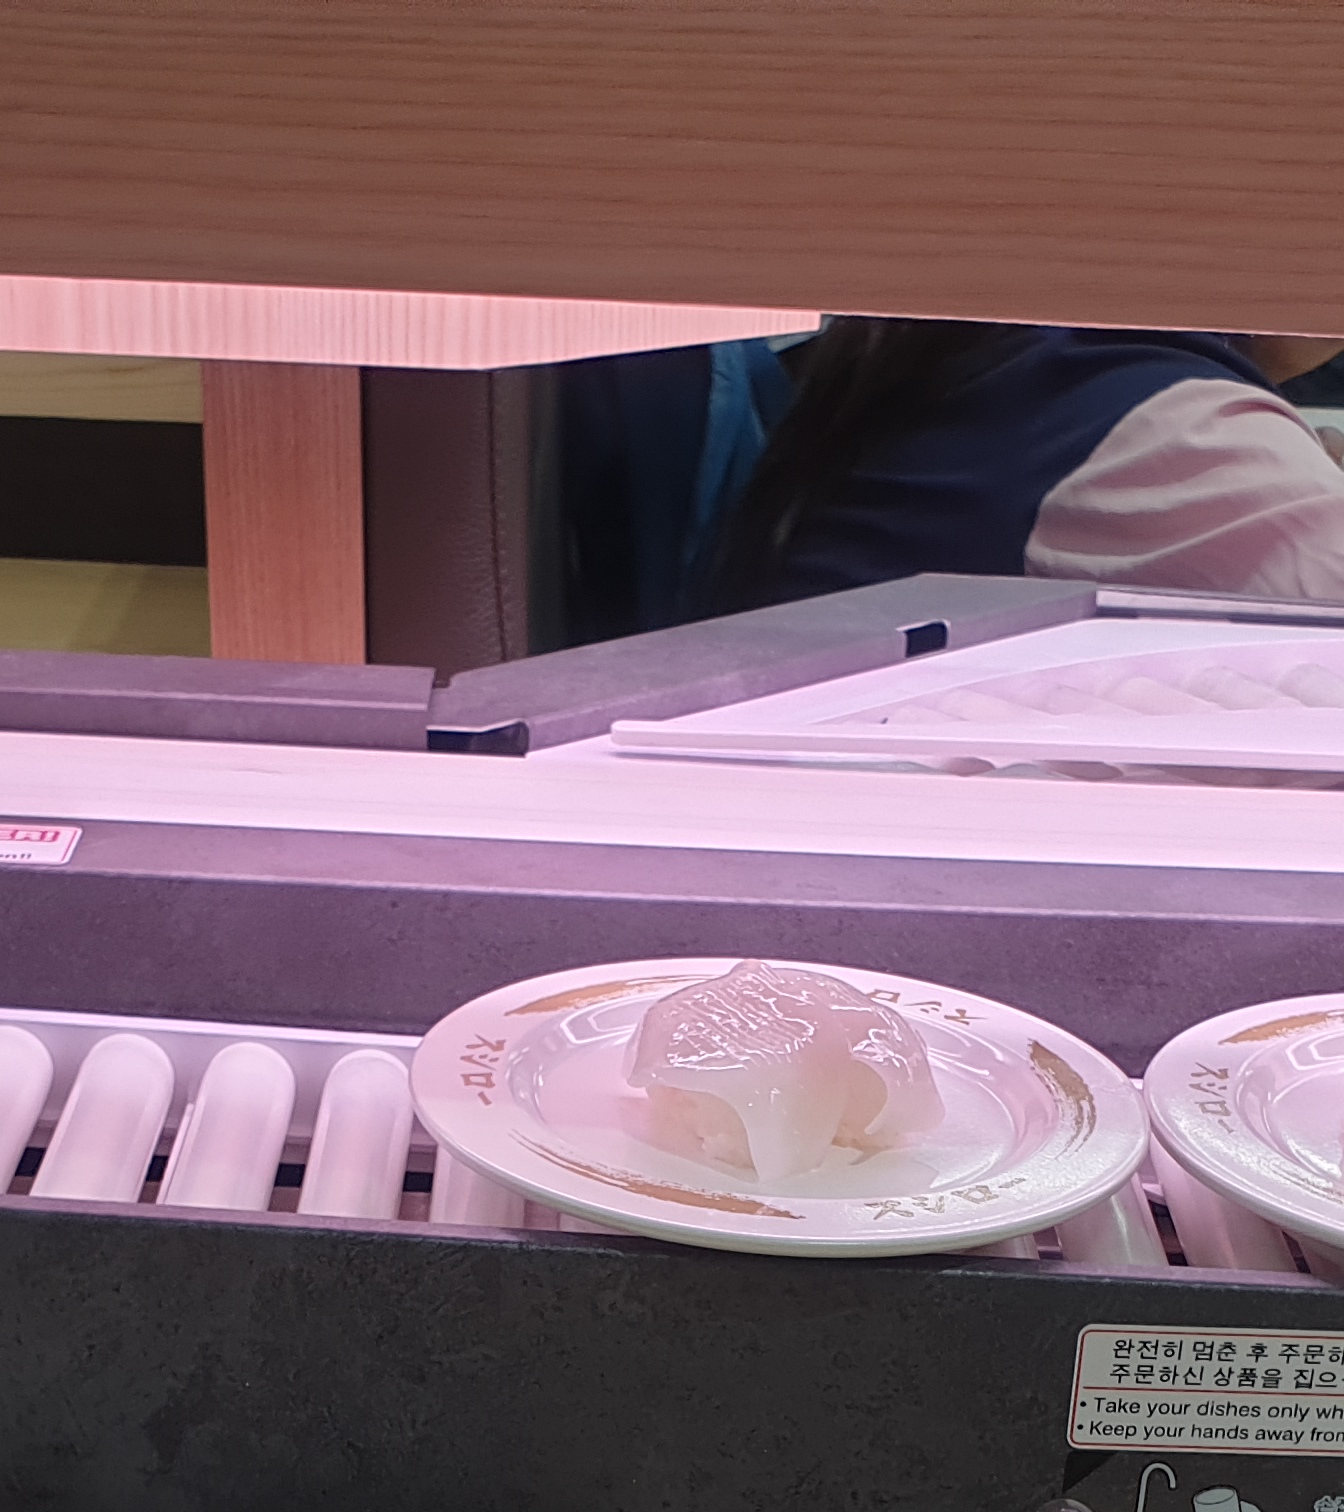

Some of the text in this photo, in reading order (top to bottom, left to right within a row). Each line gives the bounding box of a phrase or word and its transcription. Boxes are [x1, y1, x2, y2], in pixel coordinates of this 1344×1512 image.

[459, 1033, 506, 1106] スシロー
[1189, 1060, 1235, 1136] スシロー
[864, 1177, 1027, 1220] スシロー
[1112, 1338, 1184, 1361] 완전히
[1193, 1340, 1237, 1362] 멈춘
[1245, 1342, 1269, 1364] 후
[1109, 1363, 1204, 1386] 주문하신
[1213, 1366, 1283, 1390] 상품을
[1094, 1397, 1141, 1415] Take
[1146, 1403, 1191, 1420] your
[1196, 1400, 1261, 1419] dishes
[1267, 1403, 1310, 1422] only
[1089, 1420, 1138, 1440] Keep
[1142, 1424, 1186, 1442] your
[1190, 1422, 1250, 1441] hands
[1254, 1427, 1304, 1445] away
